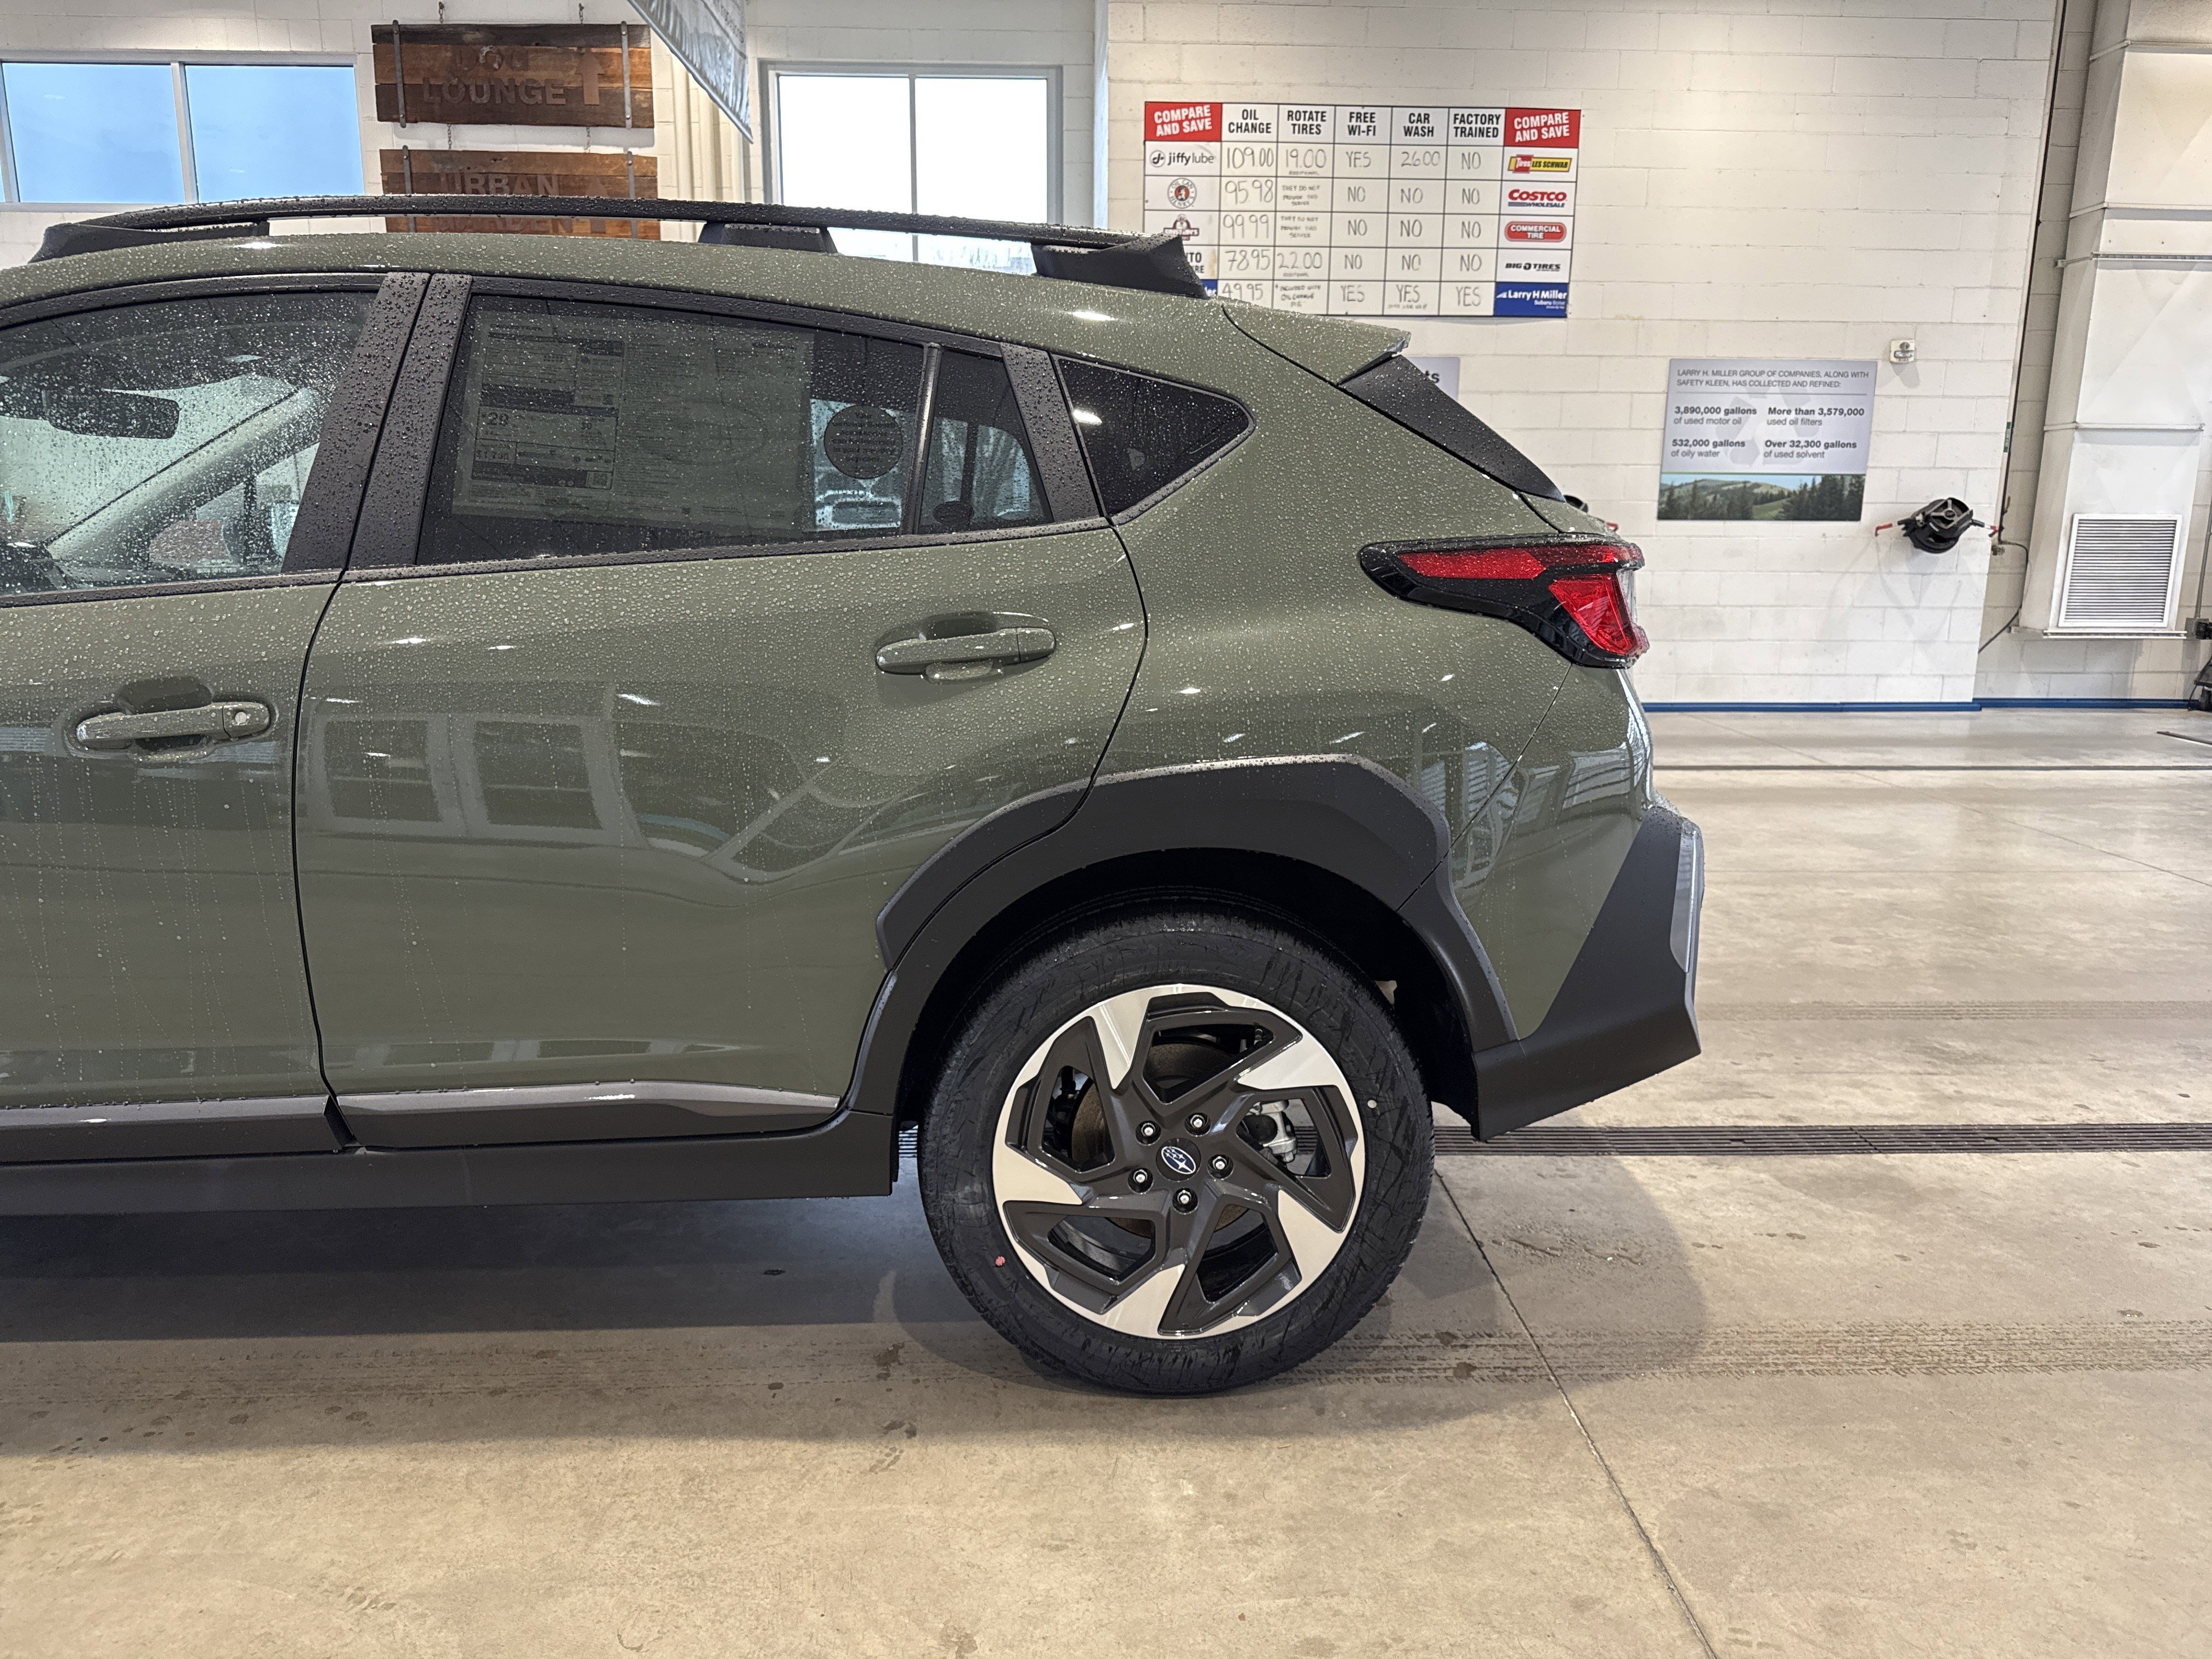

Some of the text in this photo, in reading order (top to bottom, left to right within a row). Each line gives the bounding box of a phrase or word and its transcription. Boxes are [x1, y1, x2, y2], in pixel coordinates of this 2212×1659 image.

[422, 77, 566, 105] LOUNGE
[1154, 105, 1211, 123] COMPARE
[1242, 109, 1259, 120] OIL
[1286, 110, 1327, 122] ROTATE
[1348, 112, 1376, 123] FREE
[1408, 112, 1430, 124] CAR
[1453, 113, 1501, 125] FACTORY
[1514, 112, 1570, 129] COMPARE
[1155, 119, 1212, 137] AND SAVE
[1228, 122, 1272, 134] CHANGE
[1291, 123, 1322, 135] TIRES
[1347, 125, 1376, 137] WI-FI
[1403, 126, 1435, 137] WASH
[1454, 126, 1499, 138] TRAINED
[1515, 125, 1570, 143] AND SAVE
[1346, 151, 1372, 167] YES
[1462, 151, 1481, 170] NO
[441, 173, 560, 195] URBAN
[1347, 186, 1366, 202] NO
[1400, 187, 1424, 204] NO
[1462, 188, 1481, 205] NO
[1509, 189, 1567, 201] COSTCO
[1347, 219, 1368, 236] NO
[1400, 219, 1423, 238] NO
[1461, 221, 1482, 239] NO
[1344, 254, 1363, 269] NO
[1402, 254, 1421, 271] NO
[1460, 254, 1482, 272] NO
[1340, 285, 1365, 303] YES
[1396, 284, 1420, 303] YES
[1455, 286, 1482, 307] YES
[1508, 290, 1567, 301] Larry H Miller
[1674, 406, 1757, 416] 3,890,000 gallons
[1768, 407, 1864, 417] More than 3,579,000
[1674, 416, 1682, 425] of
[1788, 417, 1798, 425] oil
[1801, 417, 1822, 426] filters
[1672, 439, 1746, 449] 532,000 gallons
[1789, 440, 1821, 449] 32,300
[1824, 441, 1857, 450] gallons
[1671, 449, 1680, 457] of
[1681, 450, 1696, 459] oily
